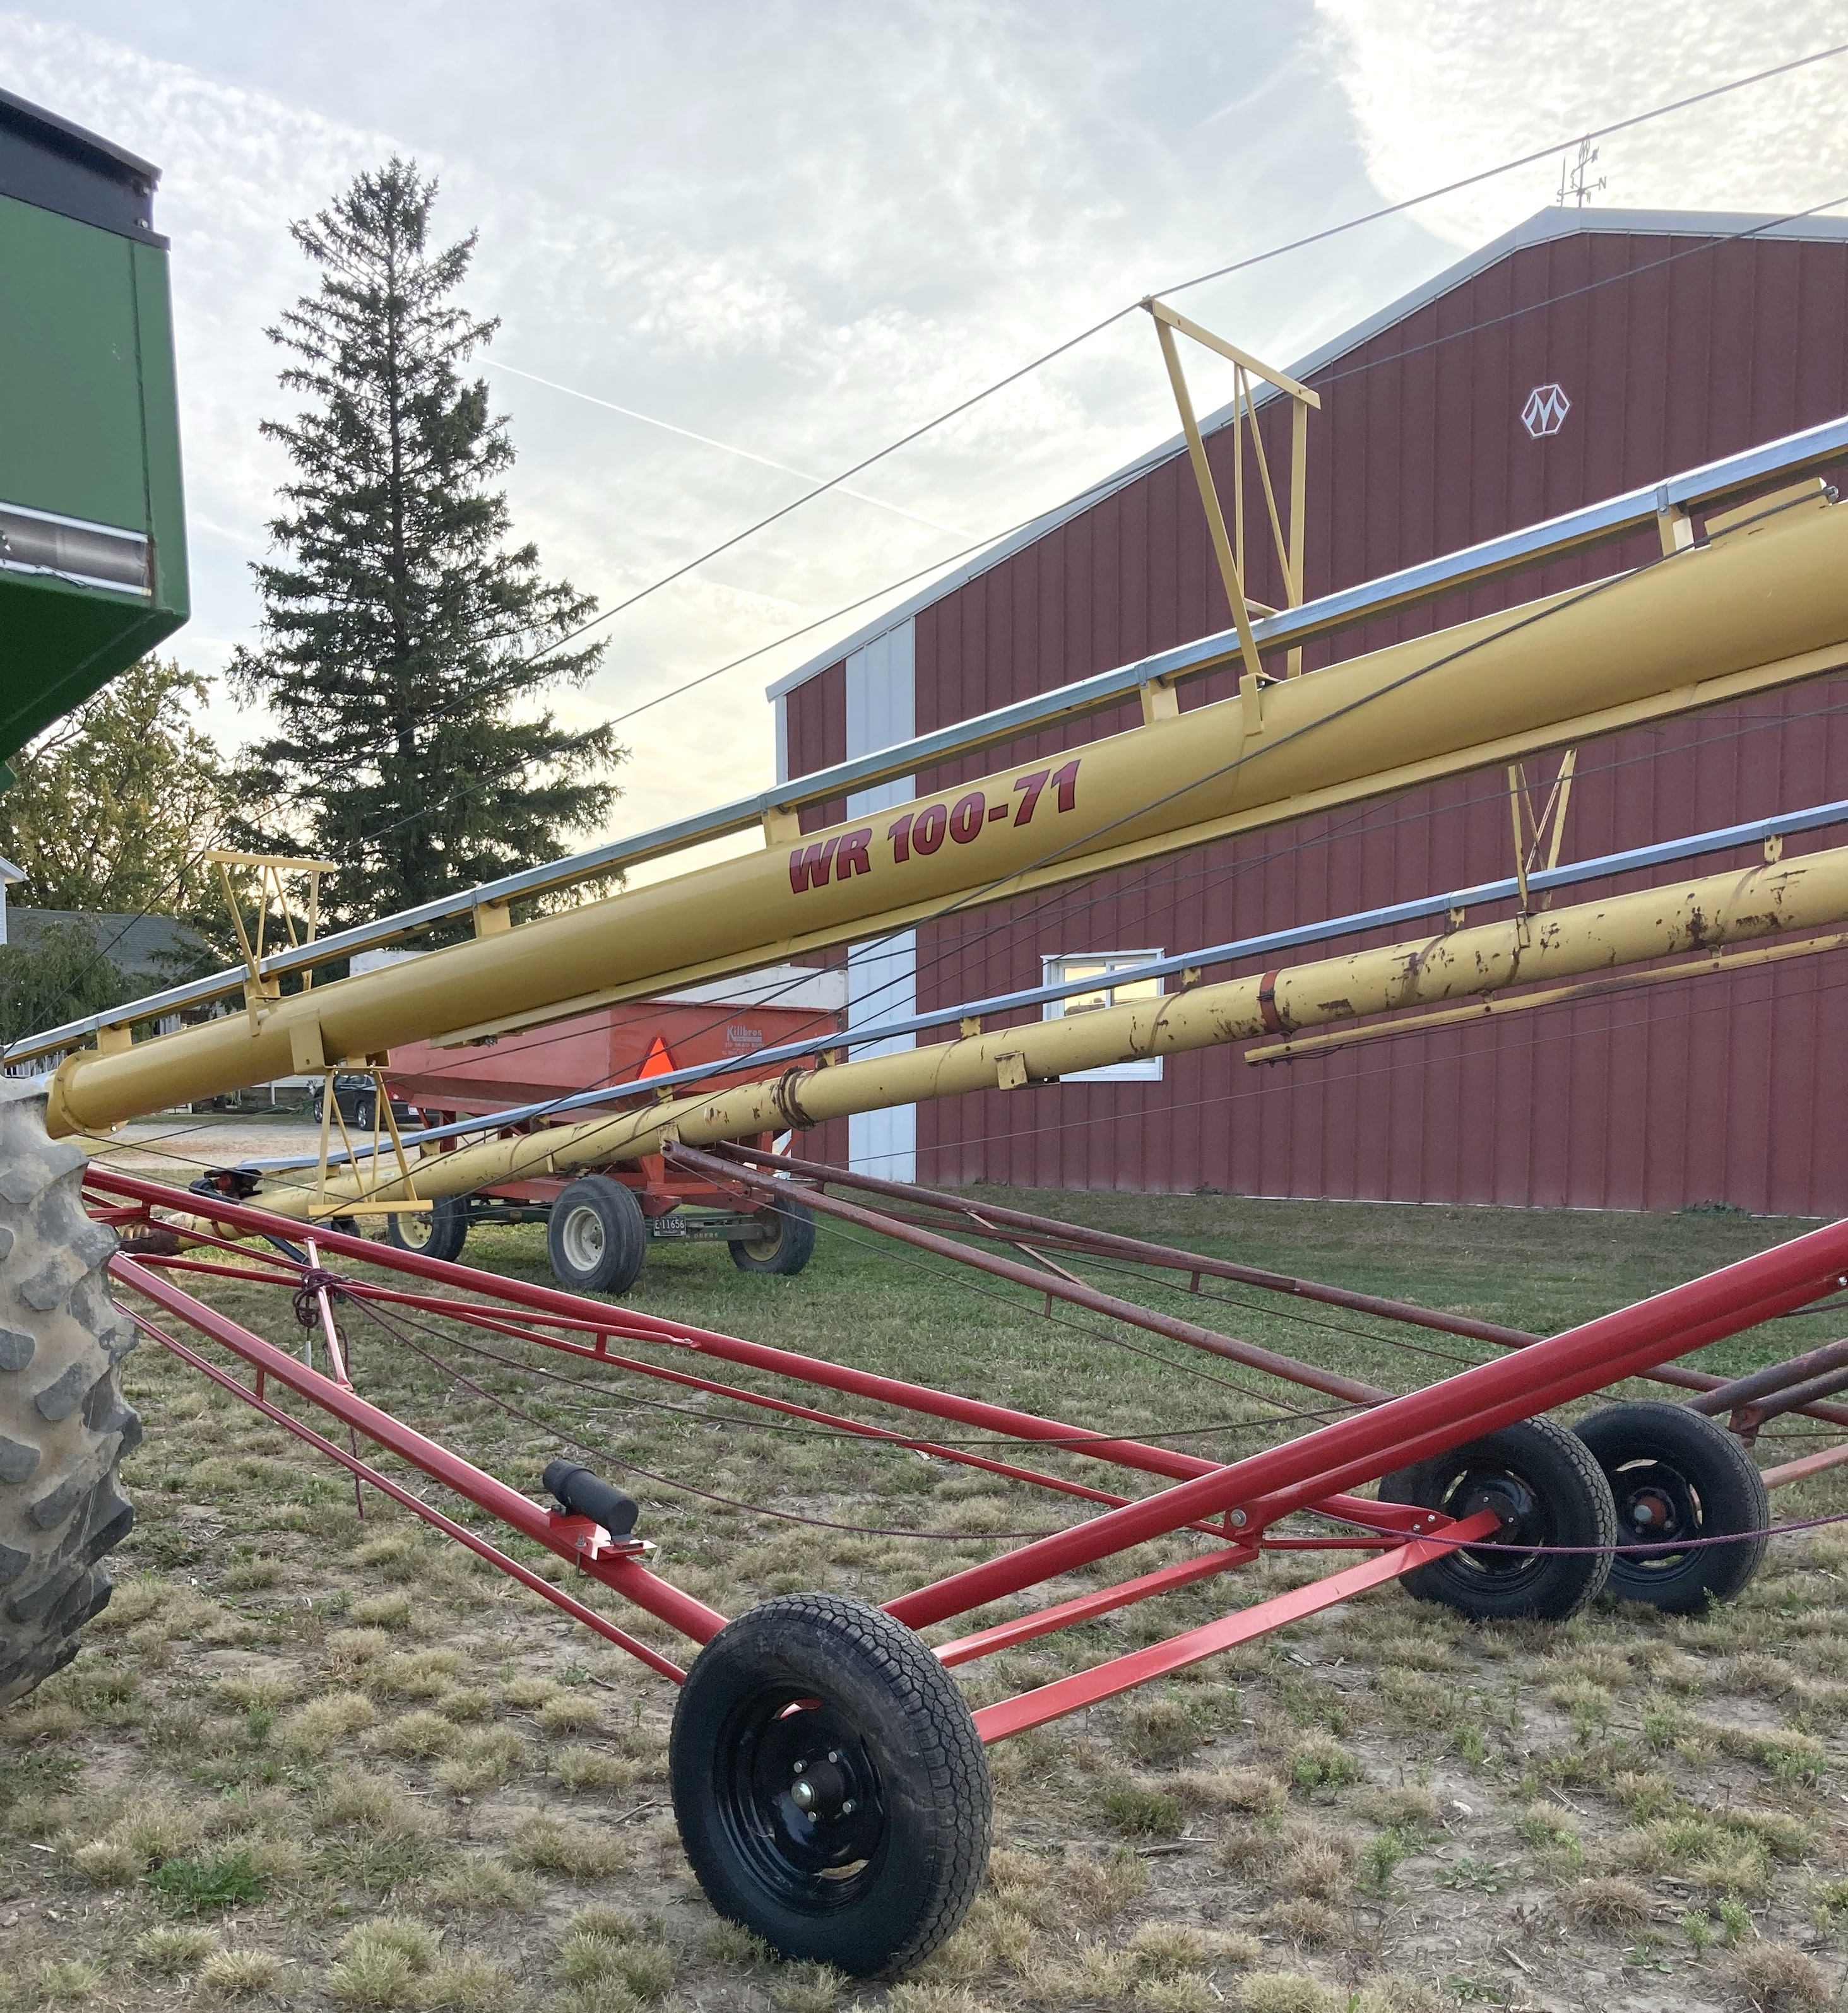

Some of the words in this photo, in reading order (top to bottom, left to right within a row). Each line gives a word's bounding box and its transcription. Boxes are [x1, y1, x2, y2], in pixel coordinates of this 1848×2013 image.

[789, 827, 872, 894] WR
[887, 759, 1082, 865] 100-71
[727, 1025, 762, 1041] Killbros
